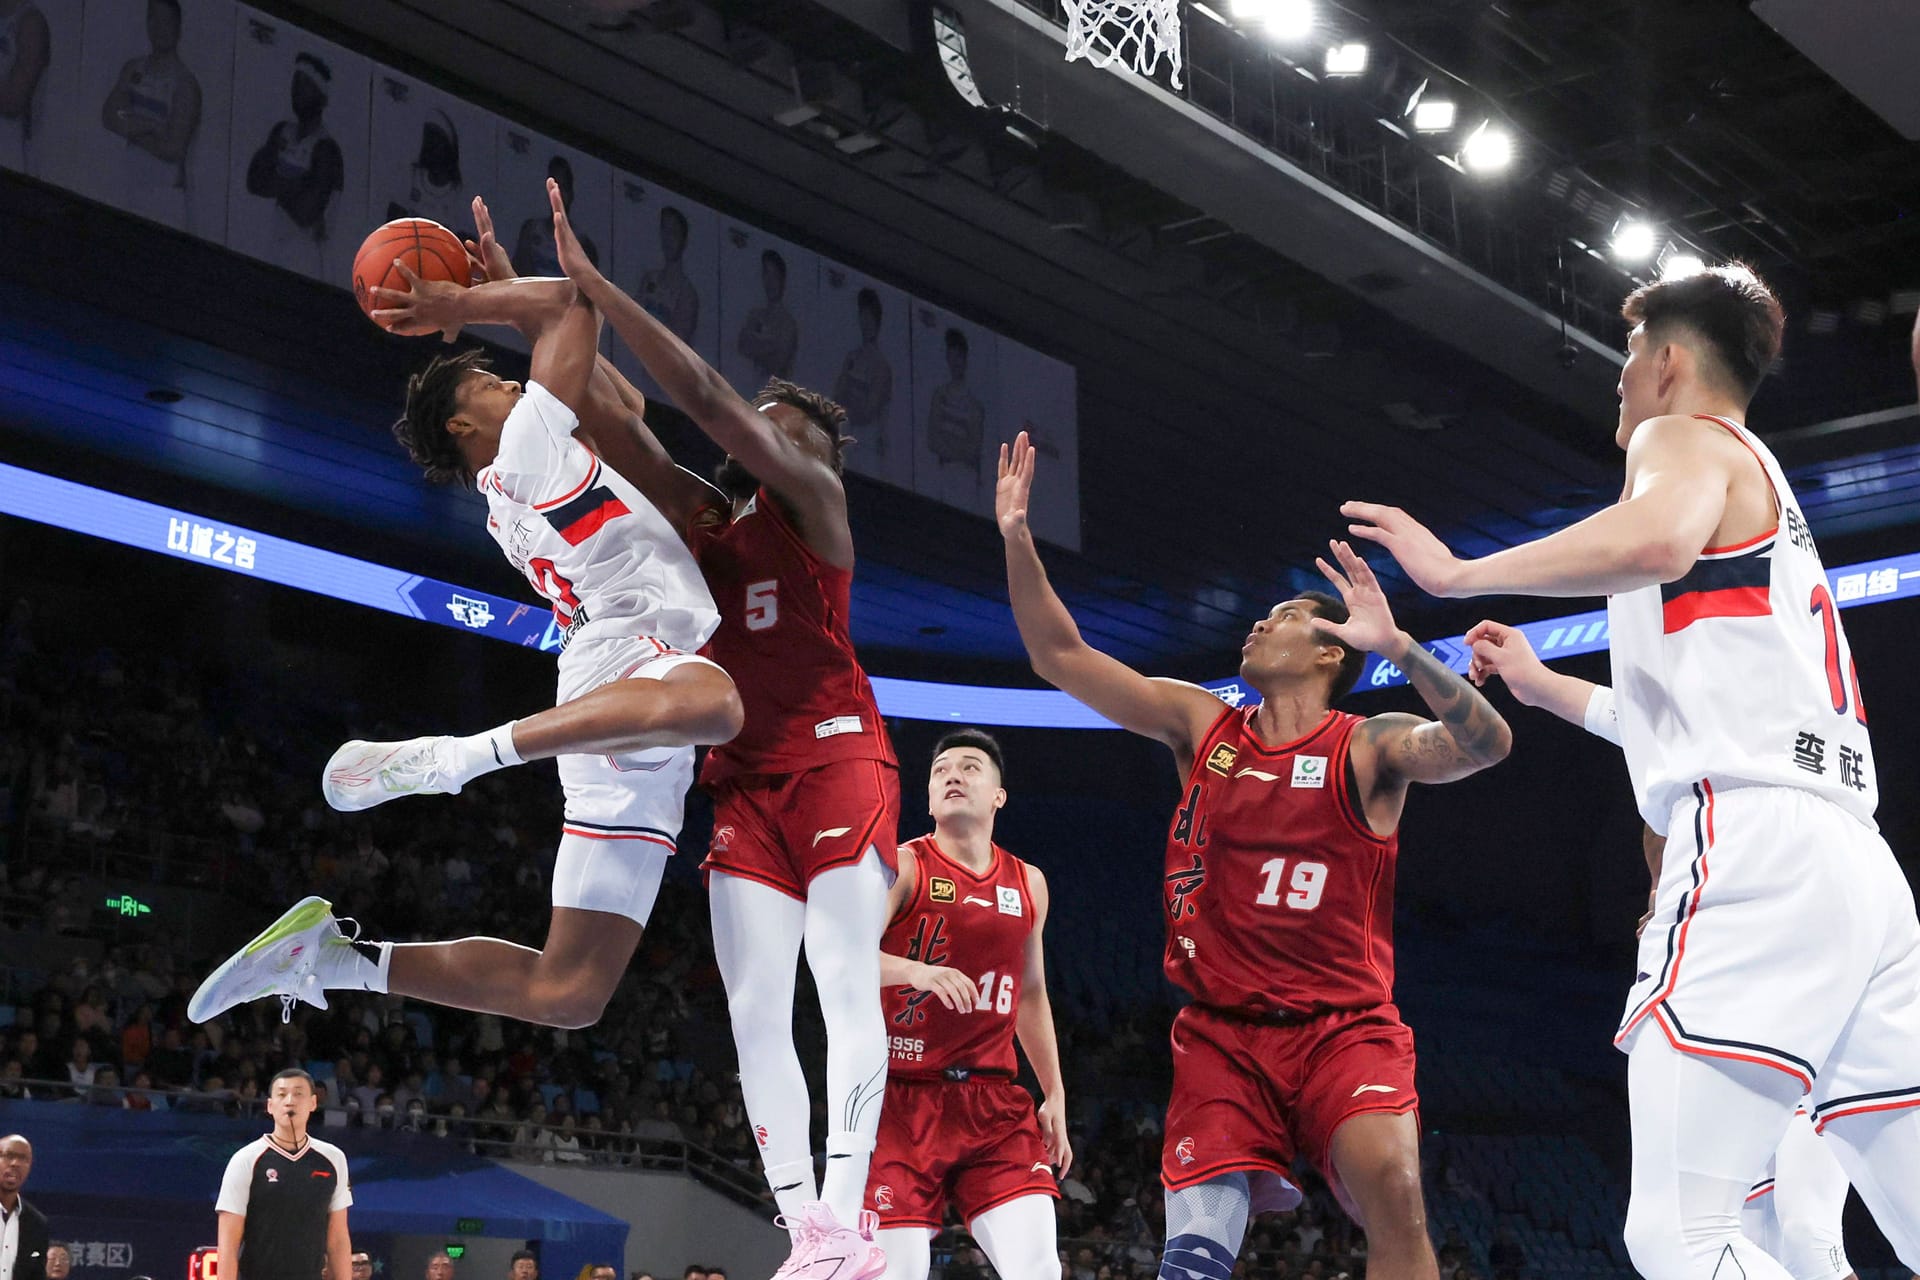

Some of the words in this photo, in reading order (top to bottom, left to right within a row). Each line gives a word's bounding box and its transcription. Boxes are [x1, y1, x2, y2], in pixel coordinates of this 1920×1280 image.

[167, 517, 257, 570] 以城之名
[746, 580, 778, 631] 5
[1256, 858, 1328, 910] 19
[975, 971, 1014, 1015] 16
